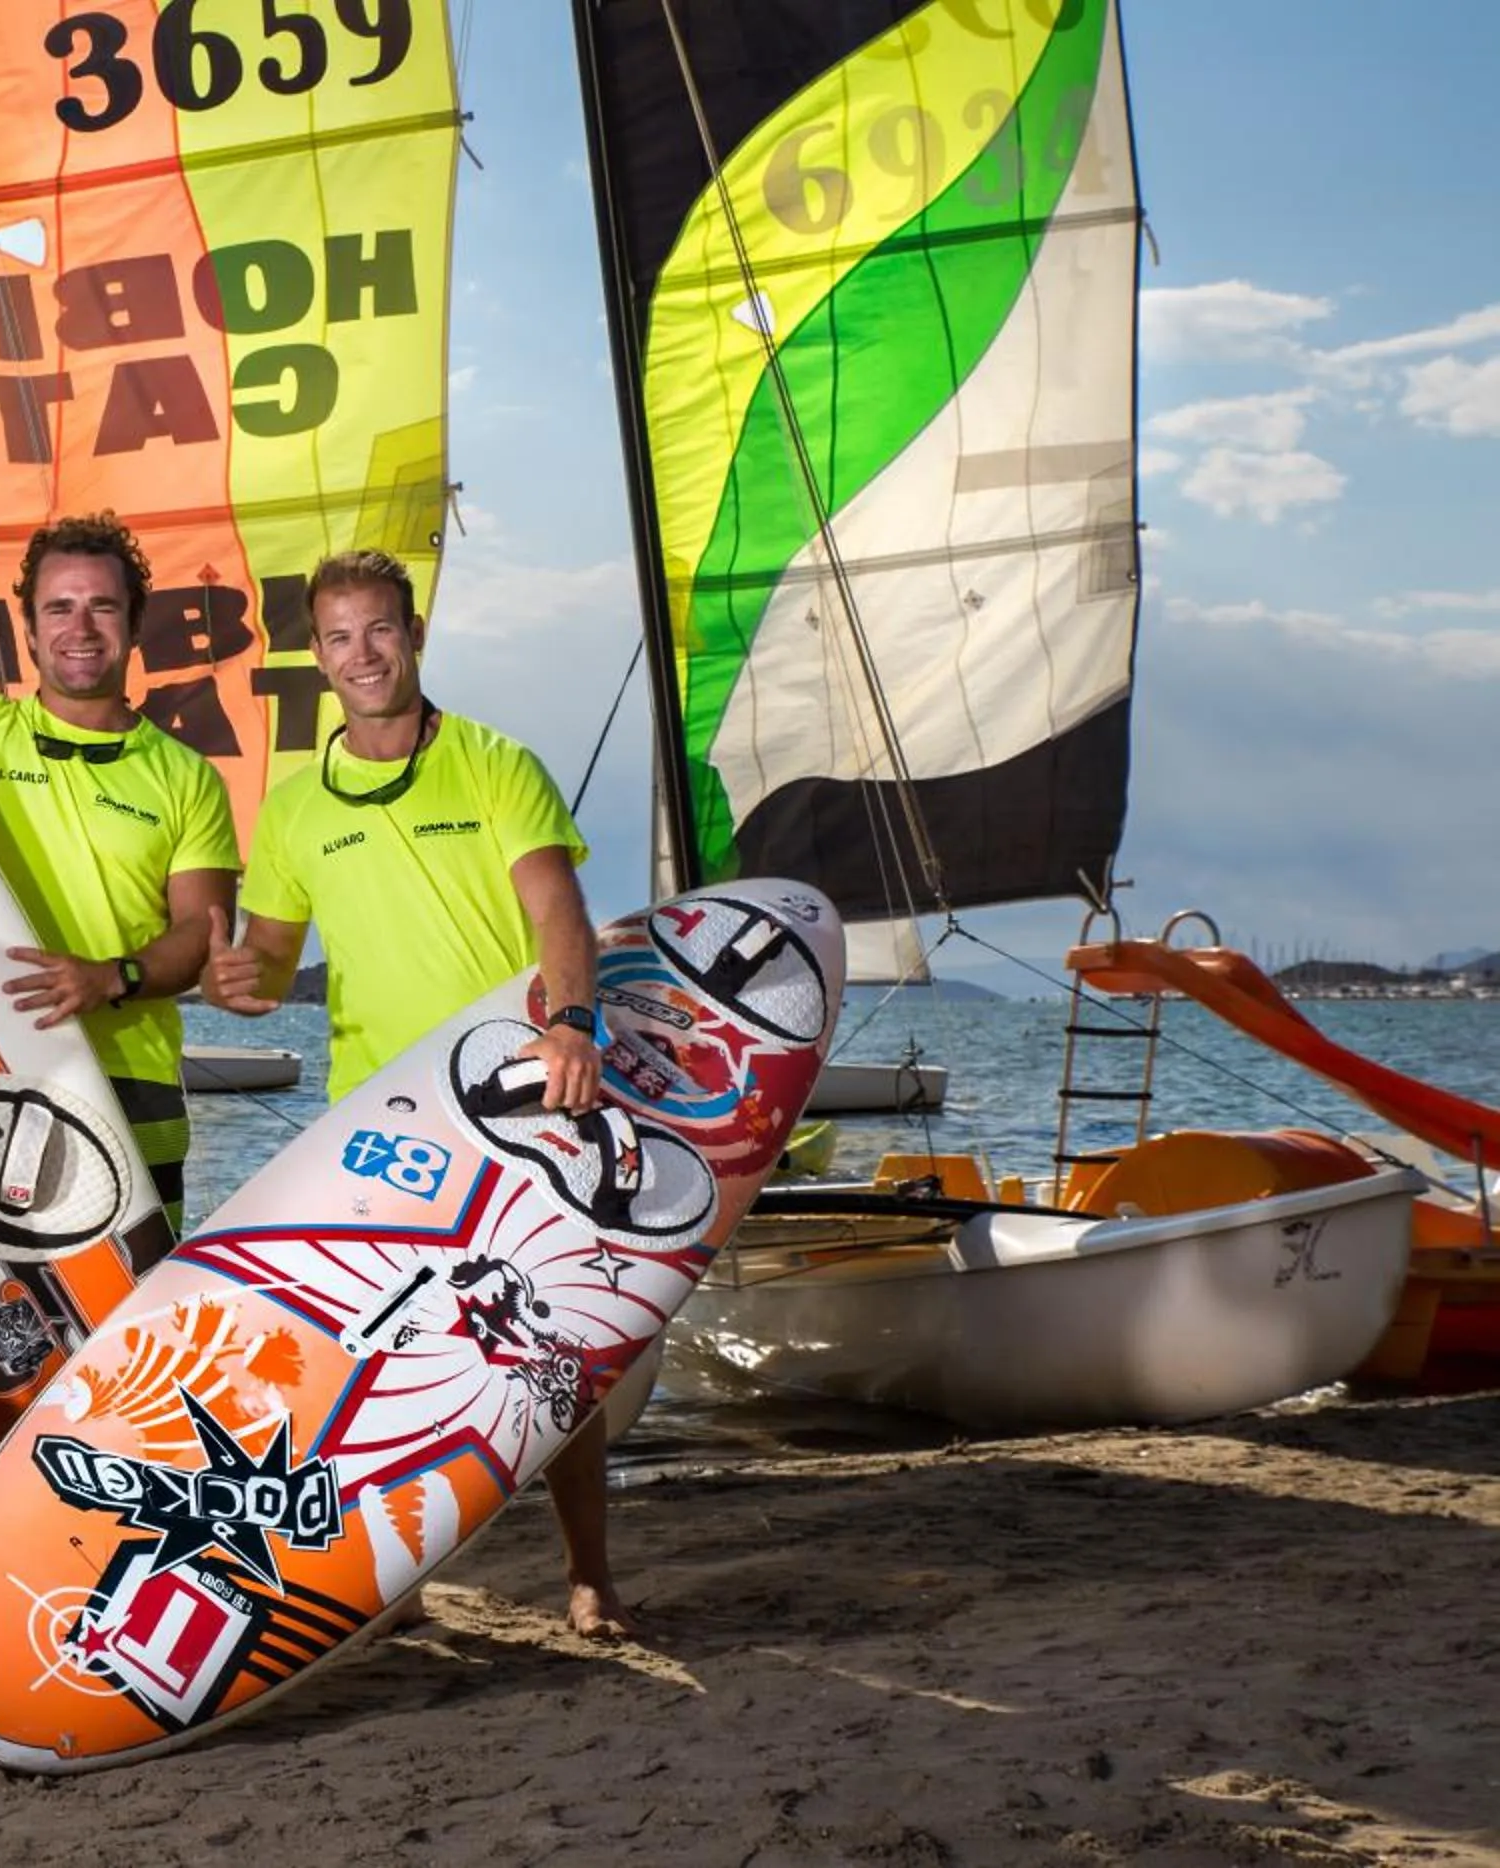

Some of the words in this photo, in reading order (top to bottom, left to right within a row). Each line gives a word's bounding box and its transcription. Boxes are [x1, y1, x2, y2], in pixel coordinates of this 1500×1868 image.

[43, 0, 412, 133] 3659
[322, 831, 366, 857] ALVARO
[350, 1132, 447, 1195] 84
